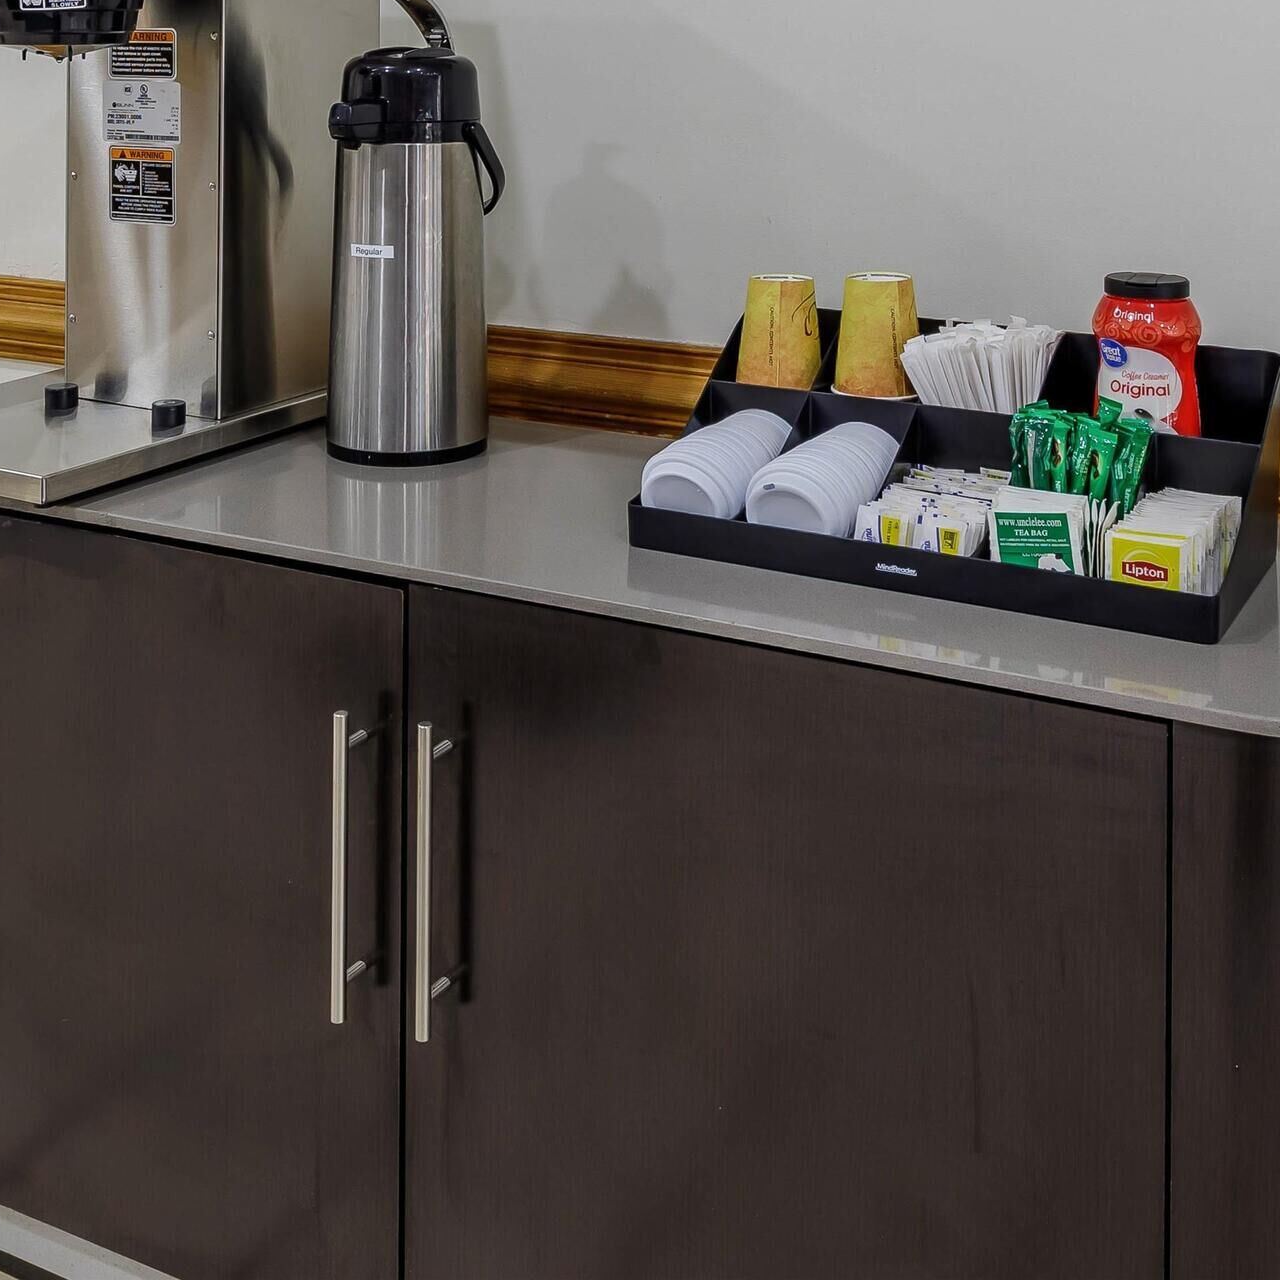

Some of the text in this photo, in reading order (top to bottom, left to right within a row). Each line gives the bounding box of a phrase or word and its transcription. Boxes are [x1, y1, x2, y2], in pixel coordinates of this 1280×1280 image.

[130, 31, 167, 41] ARNING
[129, 150, 165, 160] WARNING
[355, 246, 383, 256] Regular
[1113, 307, 1154, 324] Original
[1101, 342, 1121, 356] Great
[1121, 369, 1142, 382] Coffee
[1110, 379, 1170, 399] Original
[1014, 528, 1048, 537] TEA BAG
[1125, 563, 1165, 580] Lipton
